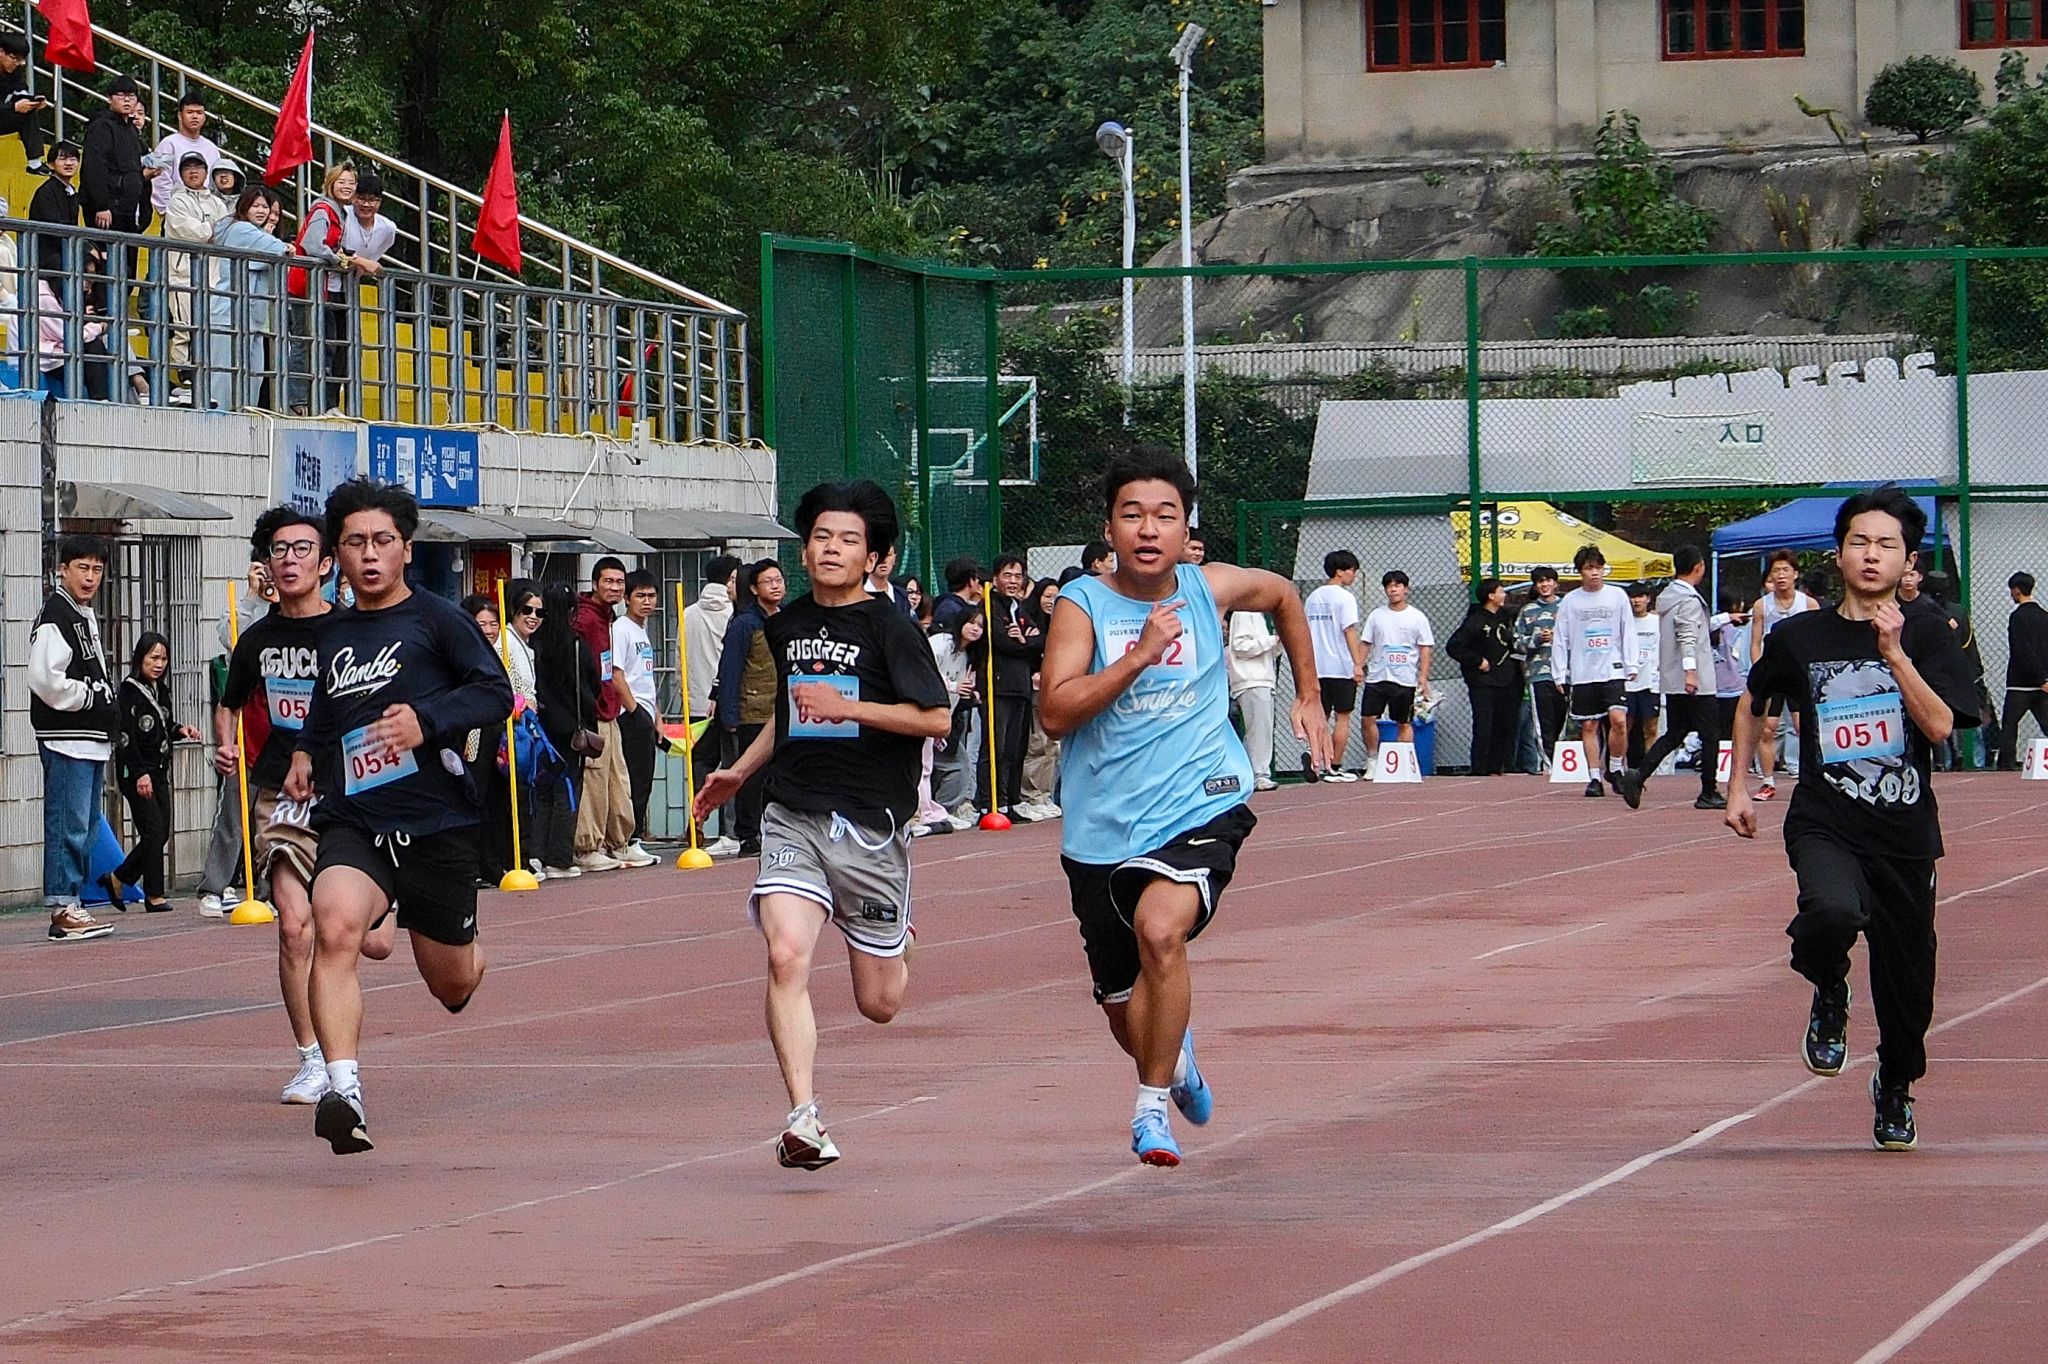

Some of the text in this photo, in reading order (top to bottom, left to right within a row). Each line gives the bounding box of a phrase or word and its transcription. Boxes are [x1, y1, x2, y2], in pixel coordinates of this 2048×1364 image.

[1718, 423, 1763, 444] 入口
[786, 638, 861, 667] RIGORER
[1588, 638, 1608, 648] 064
[278, 698, 307, 719] 05
[1834, 720, 1890, 750] 051
[352, 744, 402, 780] 054
[1385, 750, 1400, 774] 9
[1561, 748, 1578, 772] 8
[1718, 748, 1733, 772] 7
